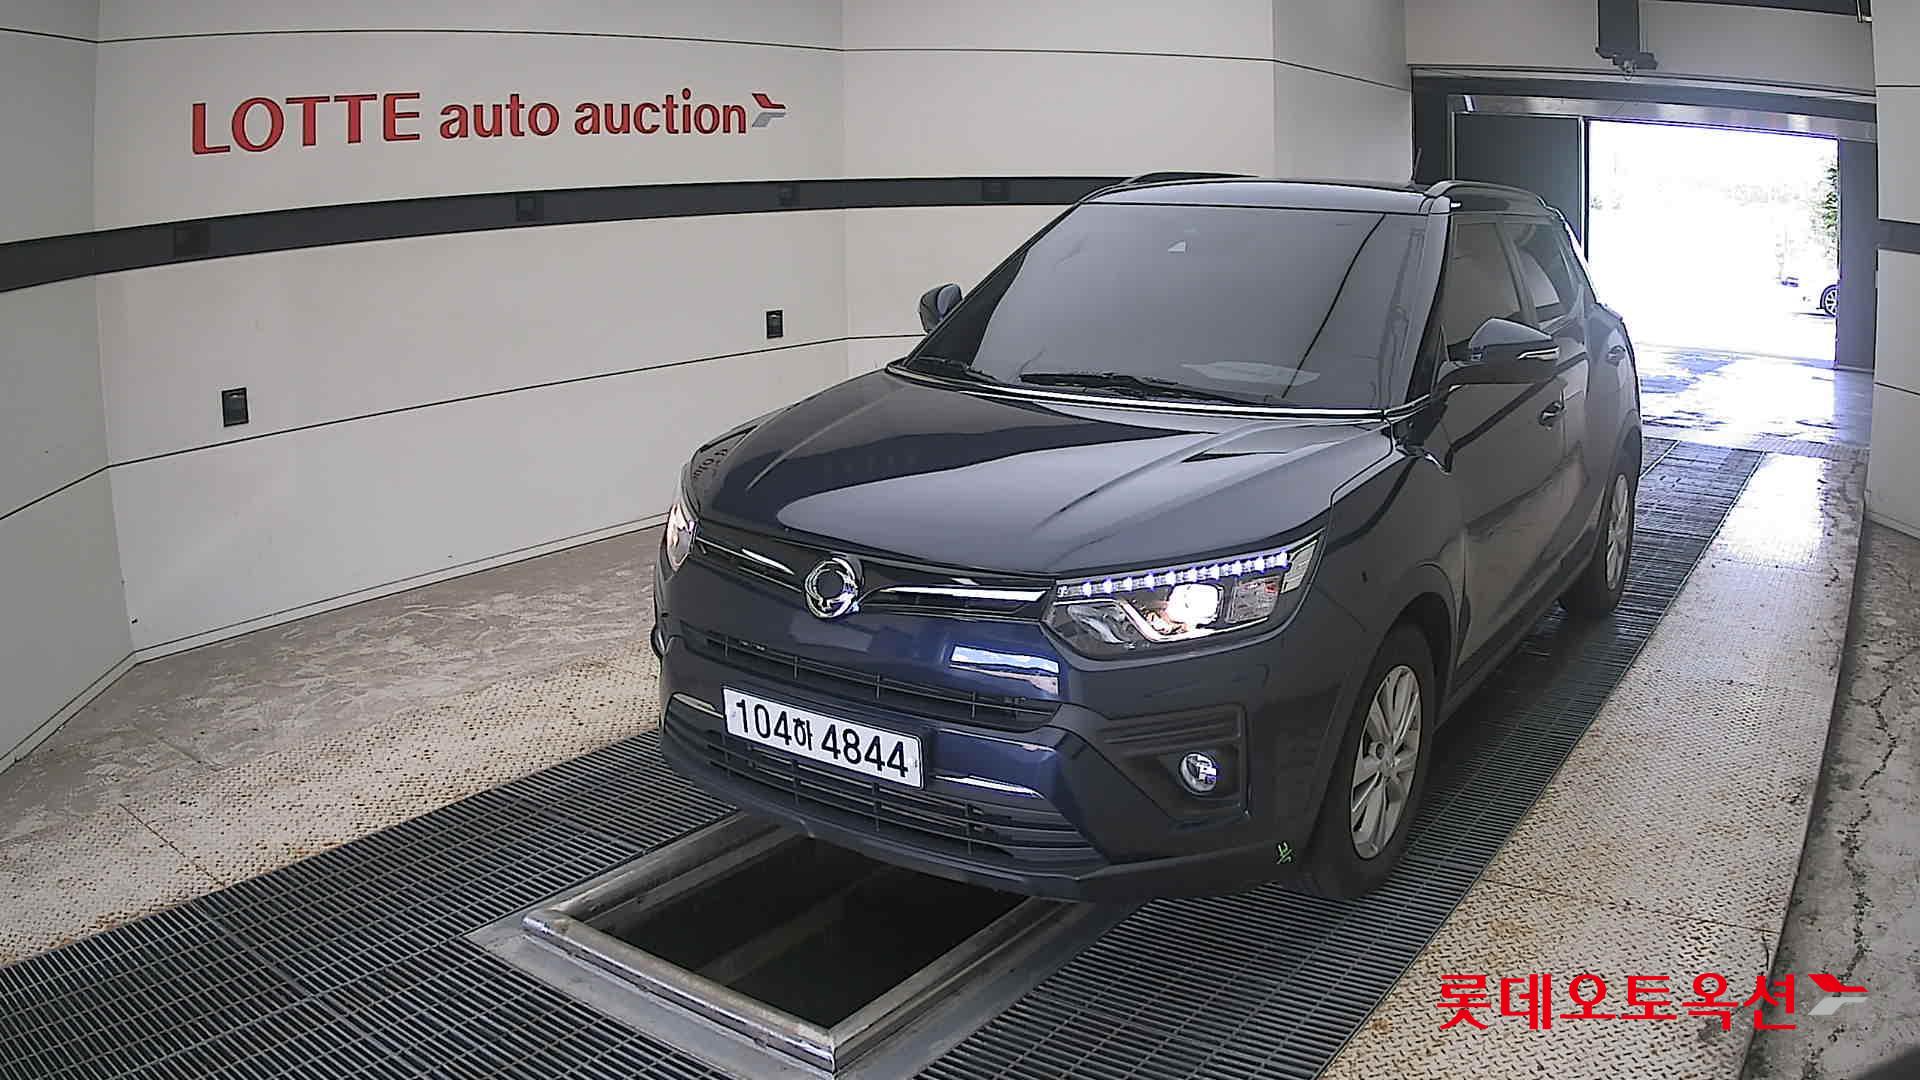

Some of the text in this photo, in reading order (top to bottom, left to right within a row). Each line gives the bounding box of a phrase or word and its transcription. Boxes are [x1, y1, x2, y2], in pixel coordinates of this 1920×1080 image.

[192, 88, 747, 155] LOTTE auto auction
[736, 699, 909, 778] 104하 4844
